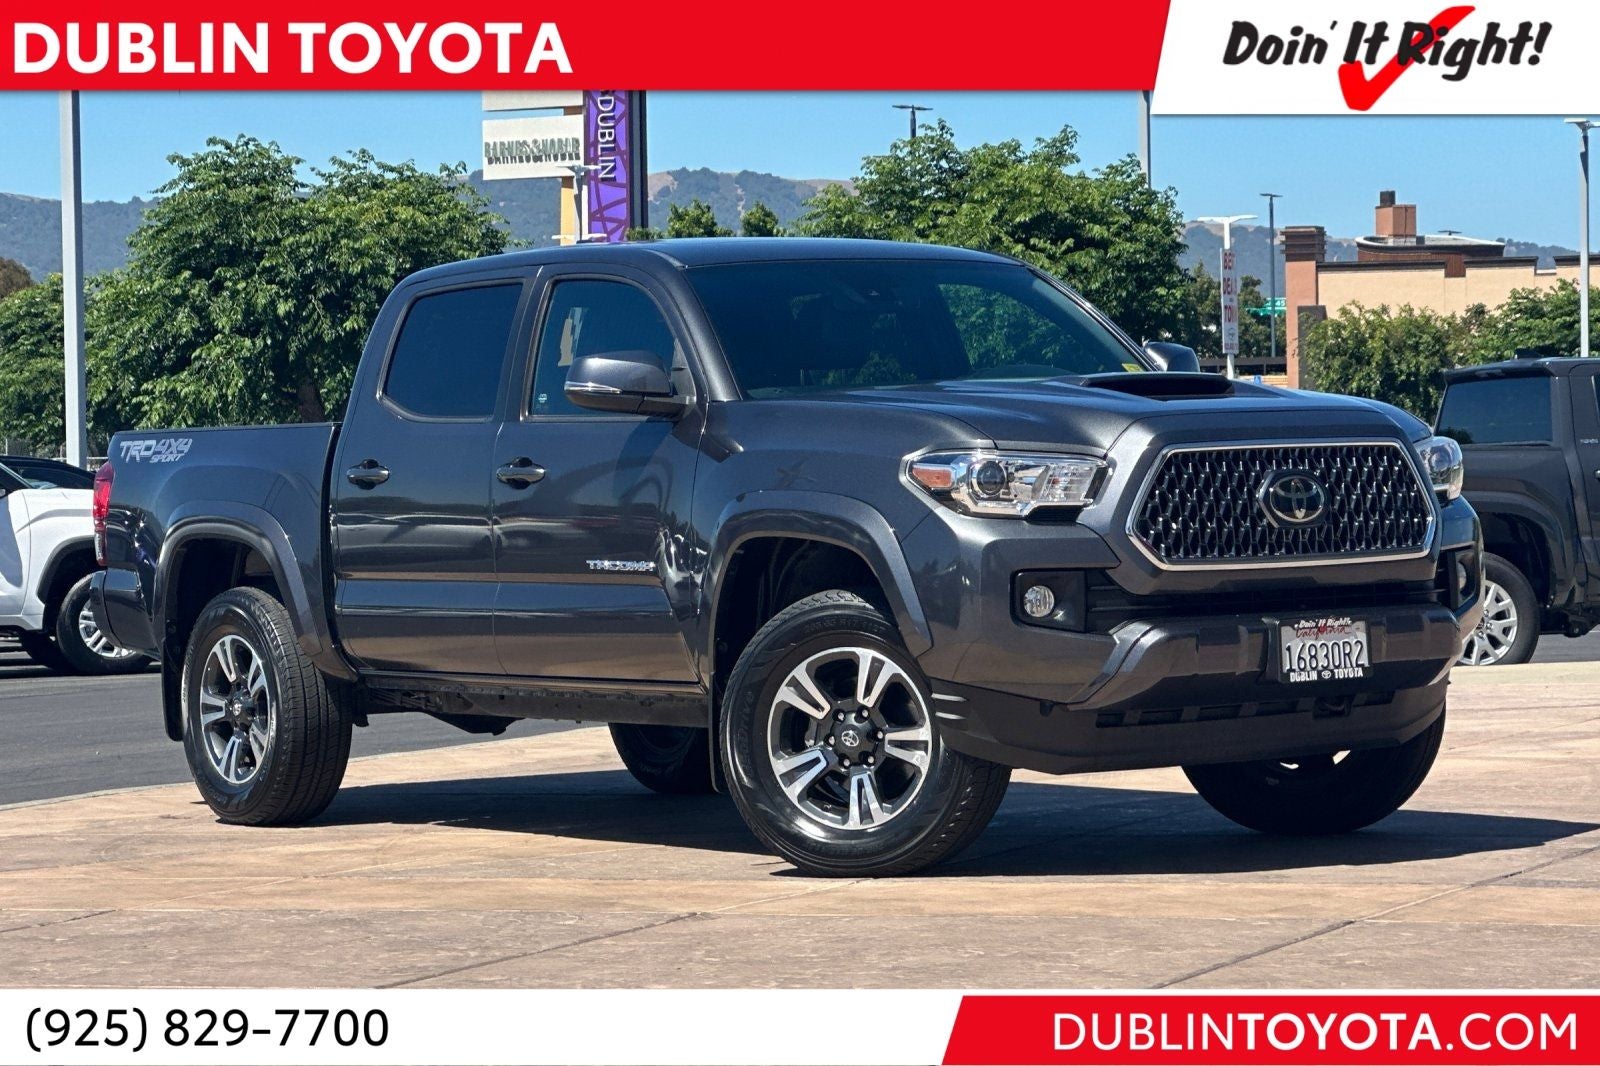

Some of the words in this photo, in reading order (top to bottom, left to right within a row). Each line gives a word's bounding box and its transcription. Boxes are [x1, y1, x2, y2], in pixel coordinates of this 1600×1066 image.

[597, 96, 616, 179] DUBLIN
[120, 439, 157, 463] TRD
[149, 453, 185, 464] SPORT
[1285, 640, 1365, 673] 16830R2
[1289, 670, 1318, 683] DUBLIN
[1334, 667, 1364, 679] TOYOTA
